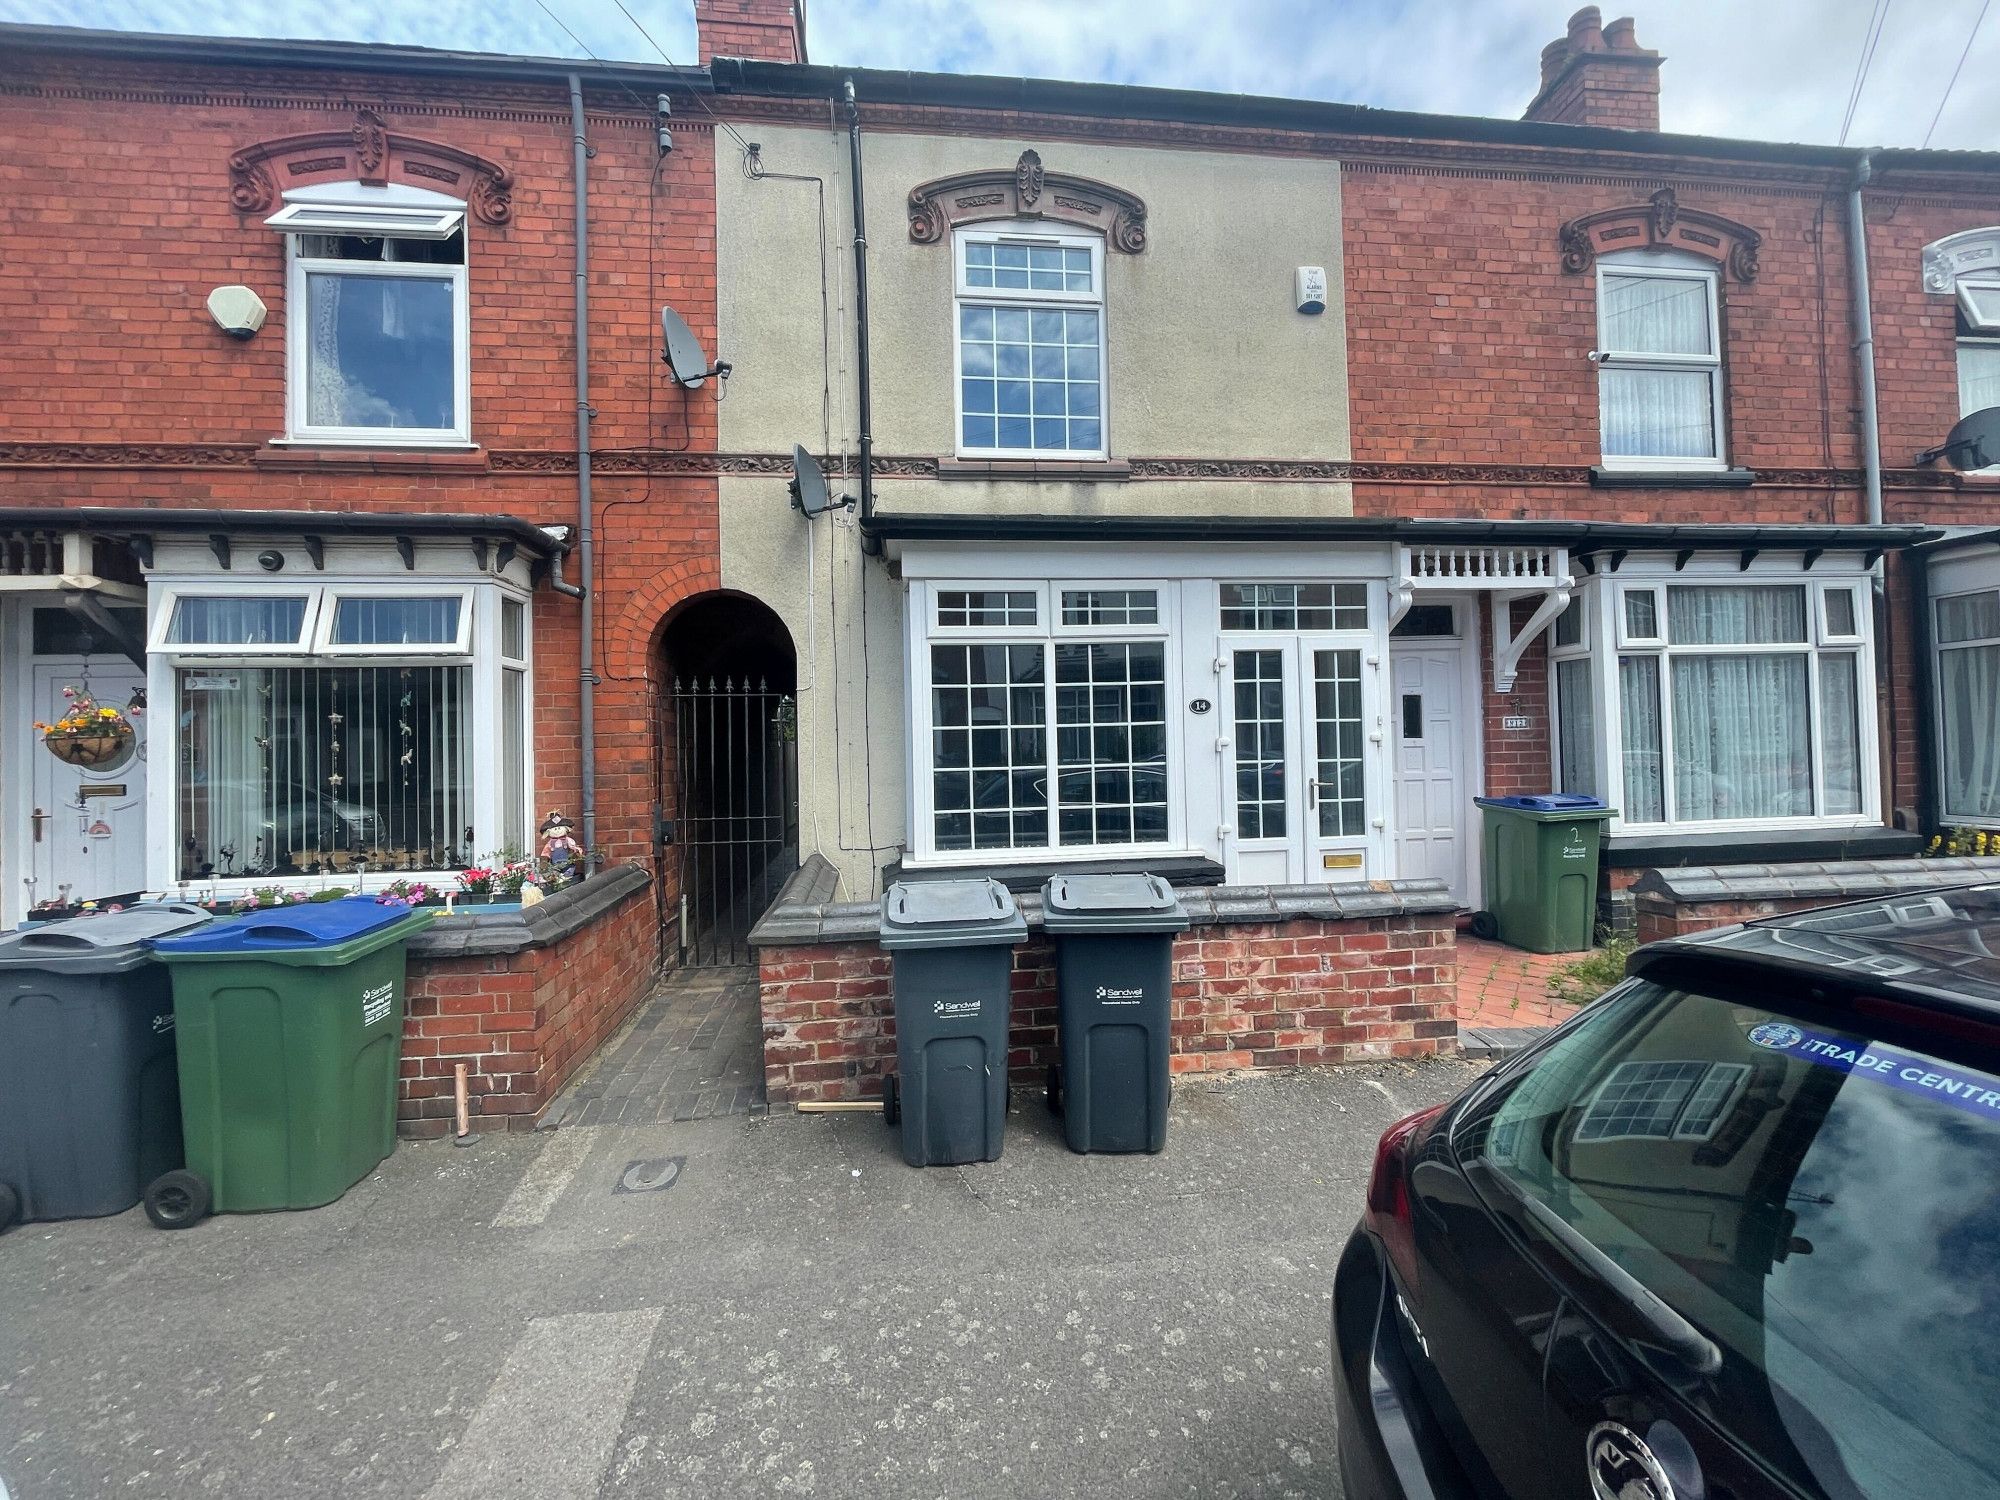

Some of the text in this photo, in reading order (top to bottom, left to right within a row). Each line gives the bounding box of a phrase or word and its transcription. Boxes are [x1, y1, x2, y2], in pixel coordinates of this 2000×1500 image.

[1195, 701, 1206, 711] 14
[1107, 988, 1143, 996] Sandwell
[945, 1000, 981, 1010] Sandwell
[1808, 1040, 2000, 1109] TRADE CENTR
